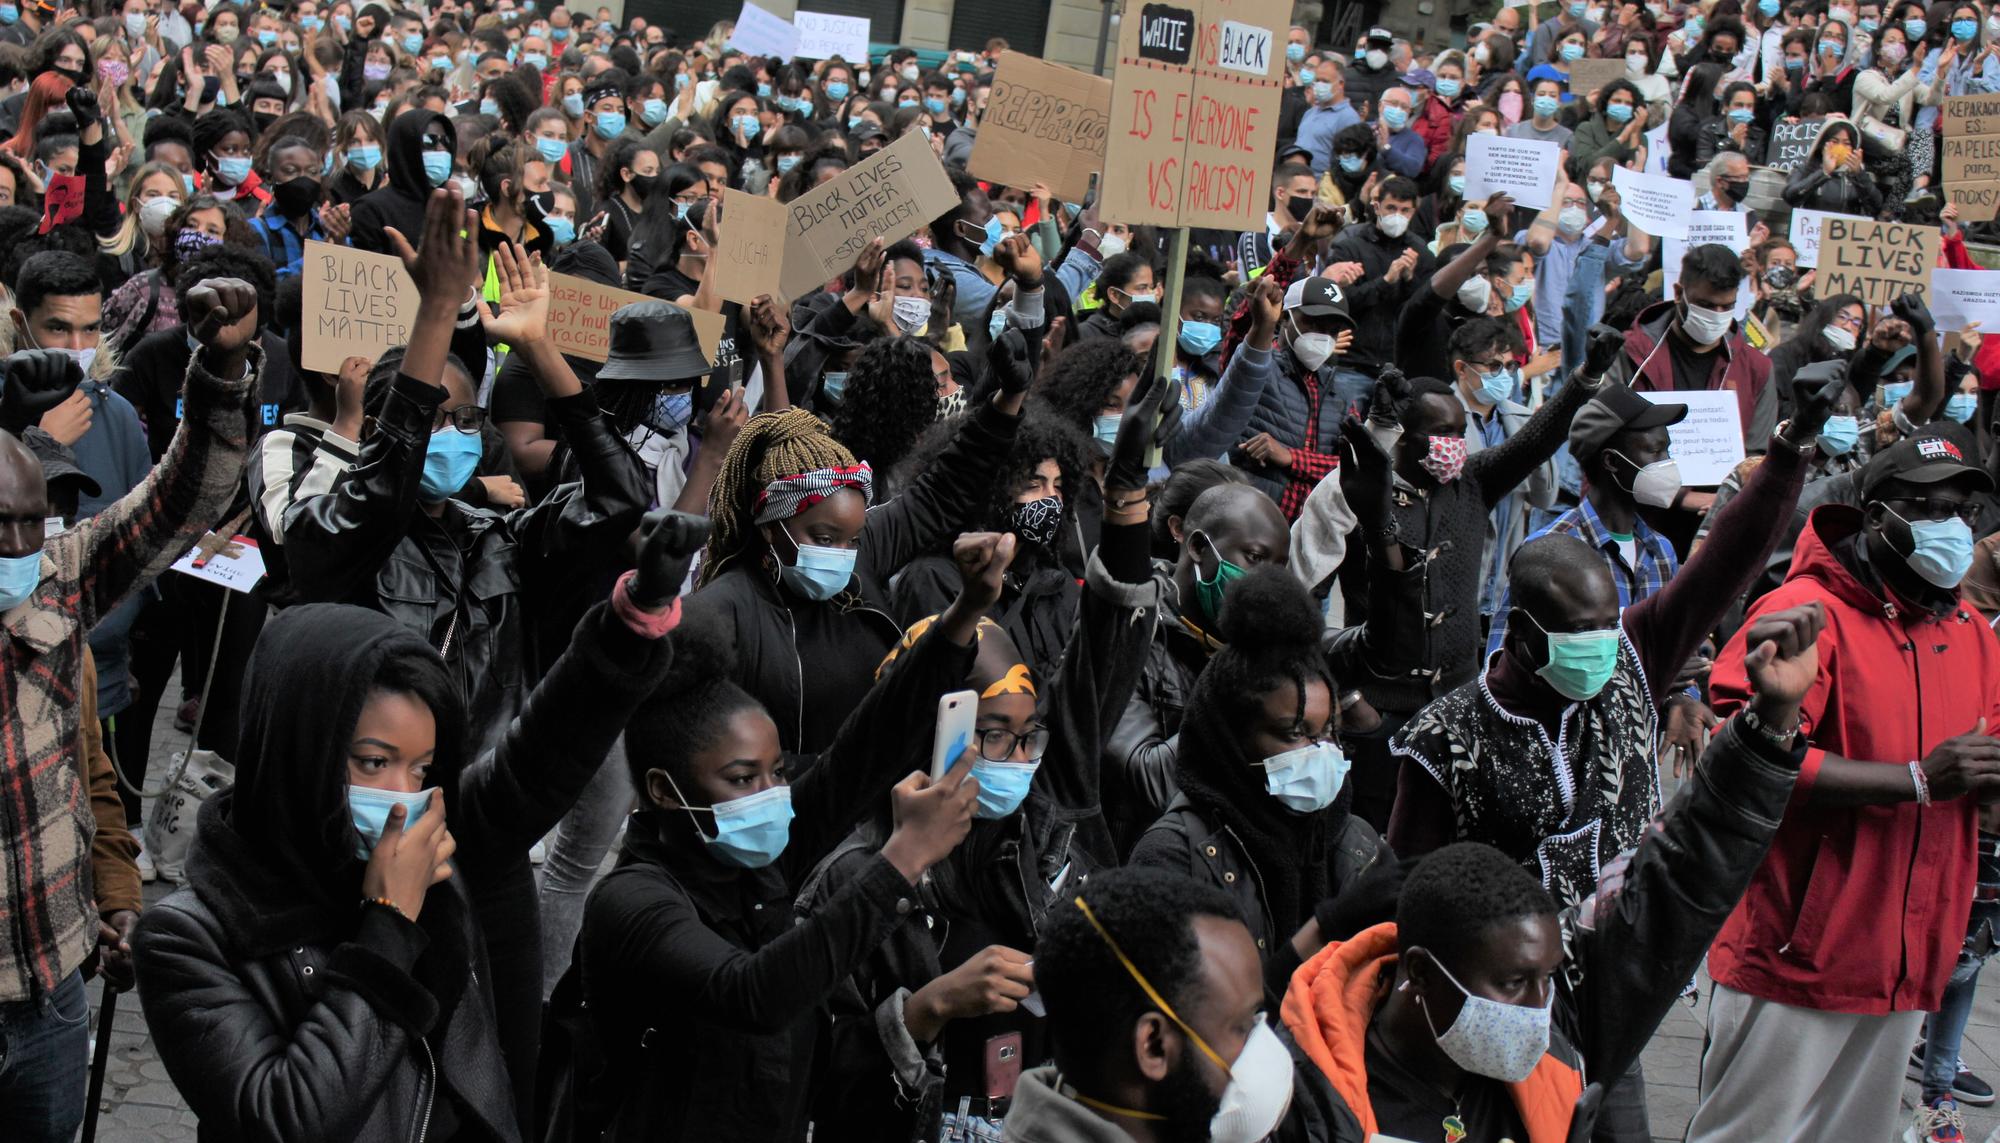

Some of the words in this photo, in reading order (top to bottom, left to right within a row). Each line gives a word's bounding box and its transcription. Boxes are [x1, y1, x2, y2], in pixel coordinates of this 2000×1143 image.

[800, 18, 817, 31] NO
[822, 20, 863, 37] JUSTICE
[801, 40, 815, 50] NO
[1142, 15, 1188, 52] WHITE
[1222, 26, 1267, 69] BLACK
[1129, 89, 1157, 141] IS
[1172, 93, 1260, 153] EVERYONE
[793, 187, 850, 238] BLACK
[848, 154, 904, 197] LIVES
[839, 181, 900, 229] MATTER
[1147, 157, 1178, 213] VS.
[1187, 160, 1256, 219] RACISM
[824, 226, 869, 270] #STOP
[867, 198, 920, 238] RACISM
[1829, 219, 1924, 250] BLACK
[320, 255, 398, 292] BLACK
[1837, 246, 1924, 276] LIVES
[325, 287, 397, 318] LIVES
[319, 313, 409, 346] MATTER
